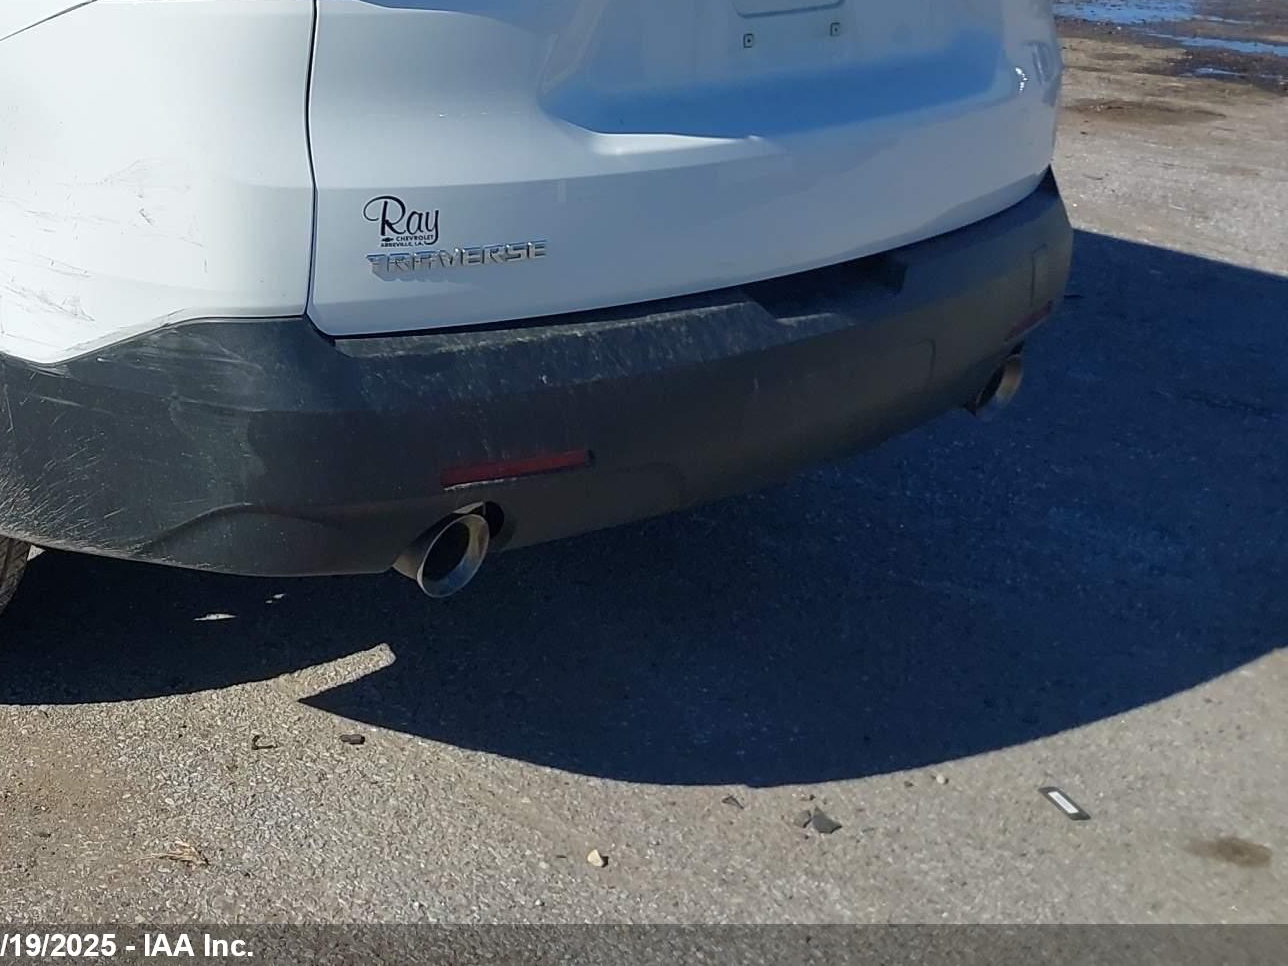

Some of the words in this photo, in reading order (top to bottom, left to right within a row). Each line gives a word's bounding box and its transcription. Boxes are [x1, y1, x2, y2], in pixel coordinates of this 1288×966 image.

[362, 195, 439, 246] Ray
[395, 234, 434, 242] CHEVROLET
[366, 239, 548, 274] TRAVERSE
